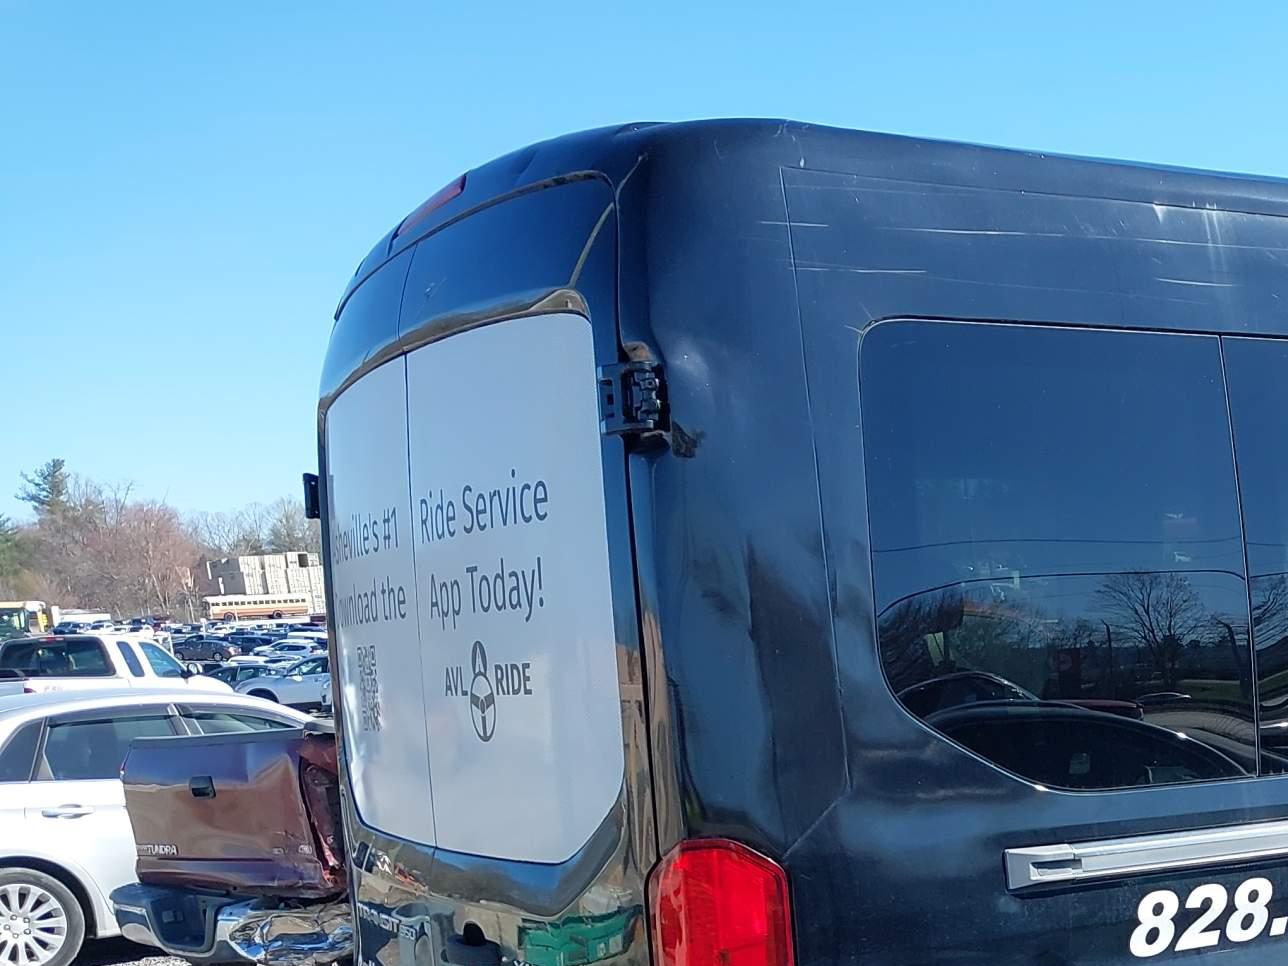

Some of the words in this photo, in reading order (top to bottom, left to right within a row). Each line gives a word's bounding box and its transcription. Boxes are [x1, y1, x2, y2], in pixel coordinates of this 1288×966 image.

[382, 506, 399, 550] #1
[420, 489, 457, 545] Ride
[461, 468, 548, 534] Service
[381, 574, 407, 621] the
[430, 573, 462, 631] App
[465, 556, 544, 623] Today!
[445, 665, 469, 697] AVL
[494, 662, 533, 696] RIDE
[144, 844, 178, 856] TUNDRA
